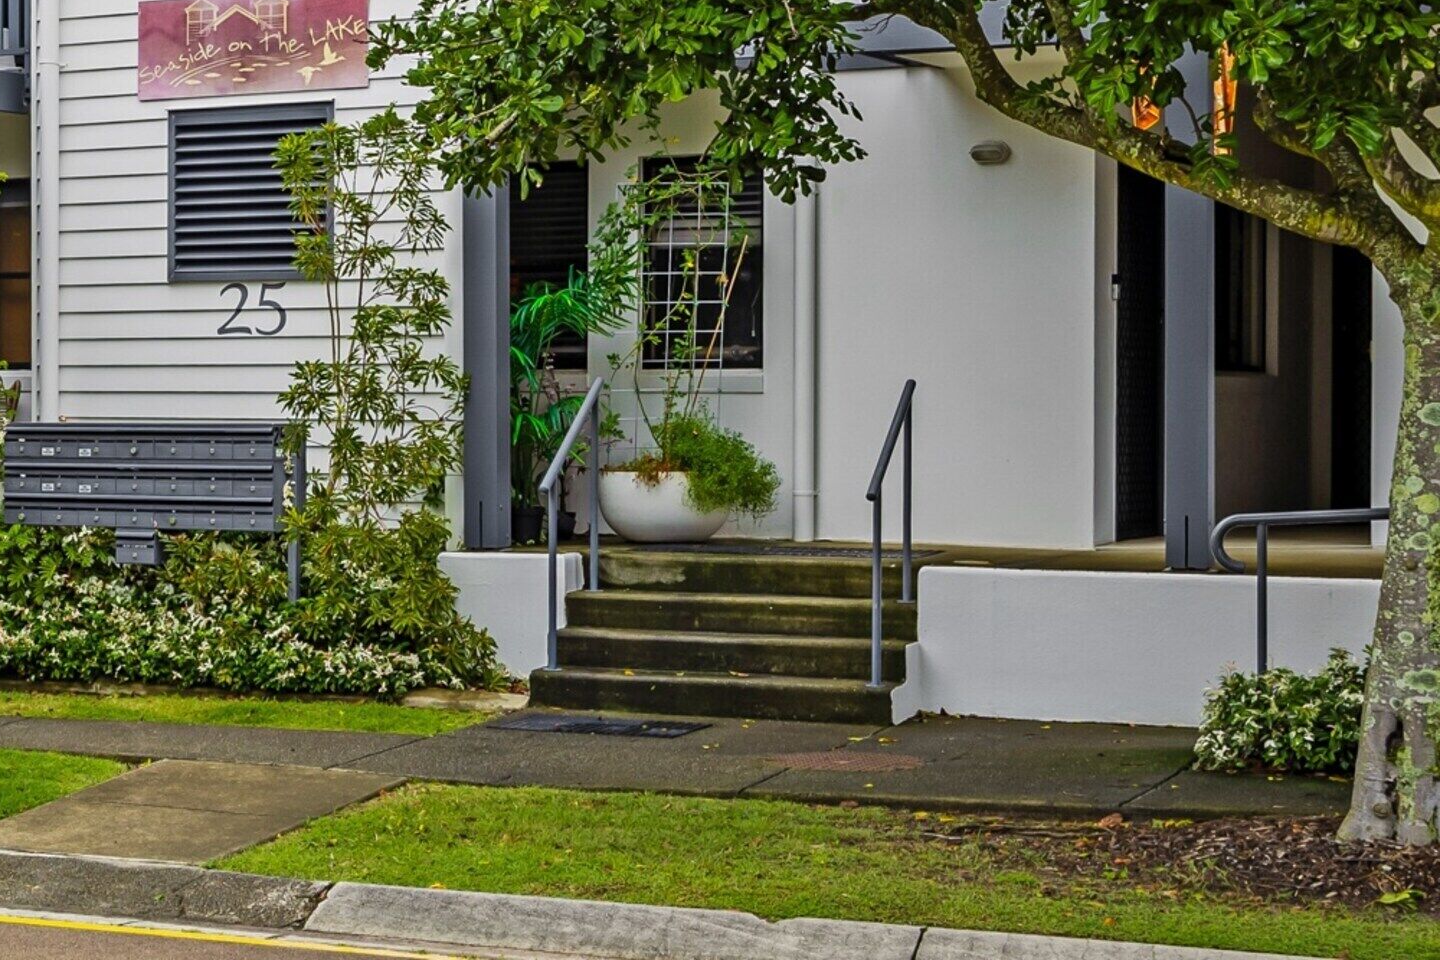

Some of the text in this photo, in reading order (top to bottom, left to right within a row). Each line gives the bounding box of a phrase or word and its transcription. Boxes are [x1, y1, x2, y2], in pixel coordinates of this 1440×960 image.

[228, 41, 252, 52] on
[309, 15, 366, 46] LAKE
[217, 281, 287, 335] 25
